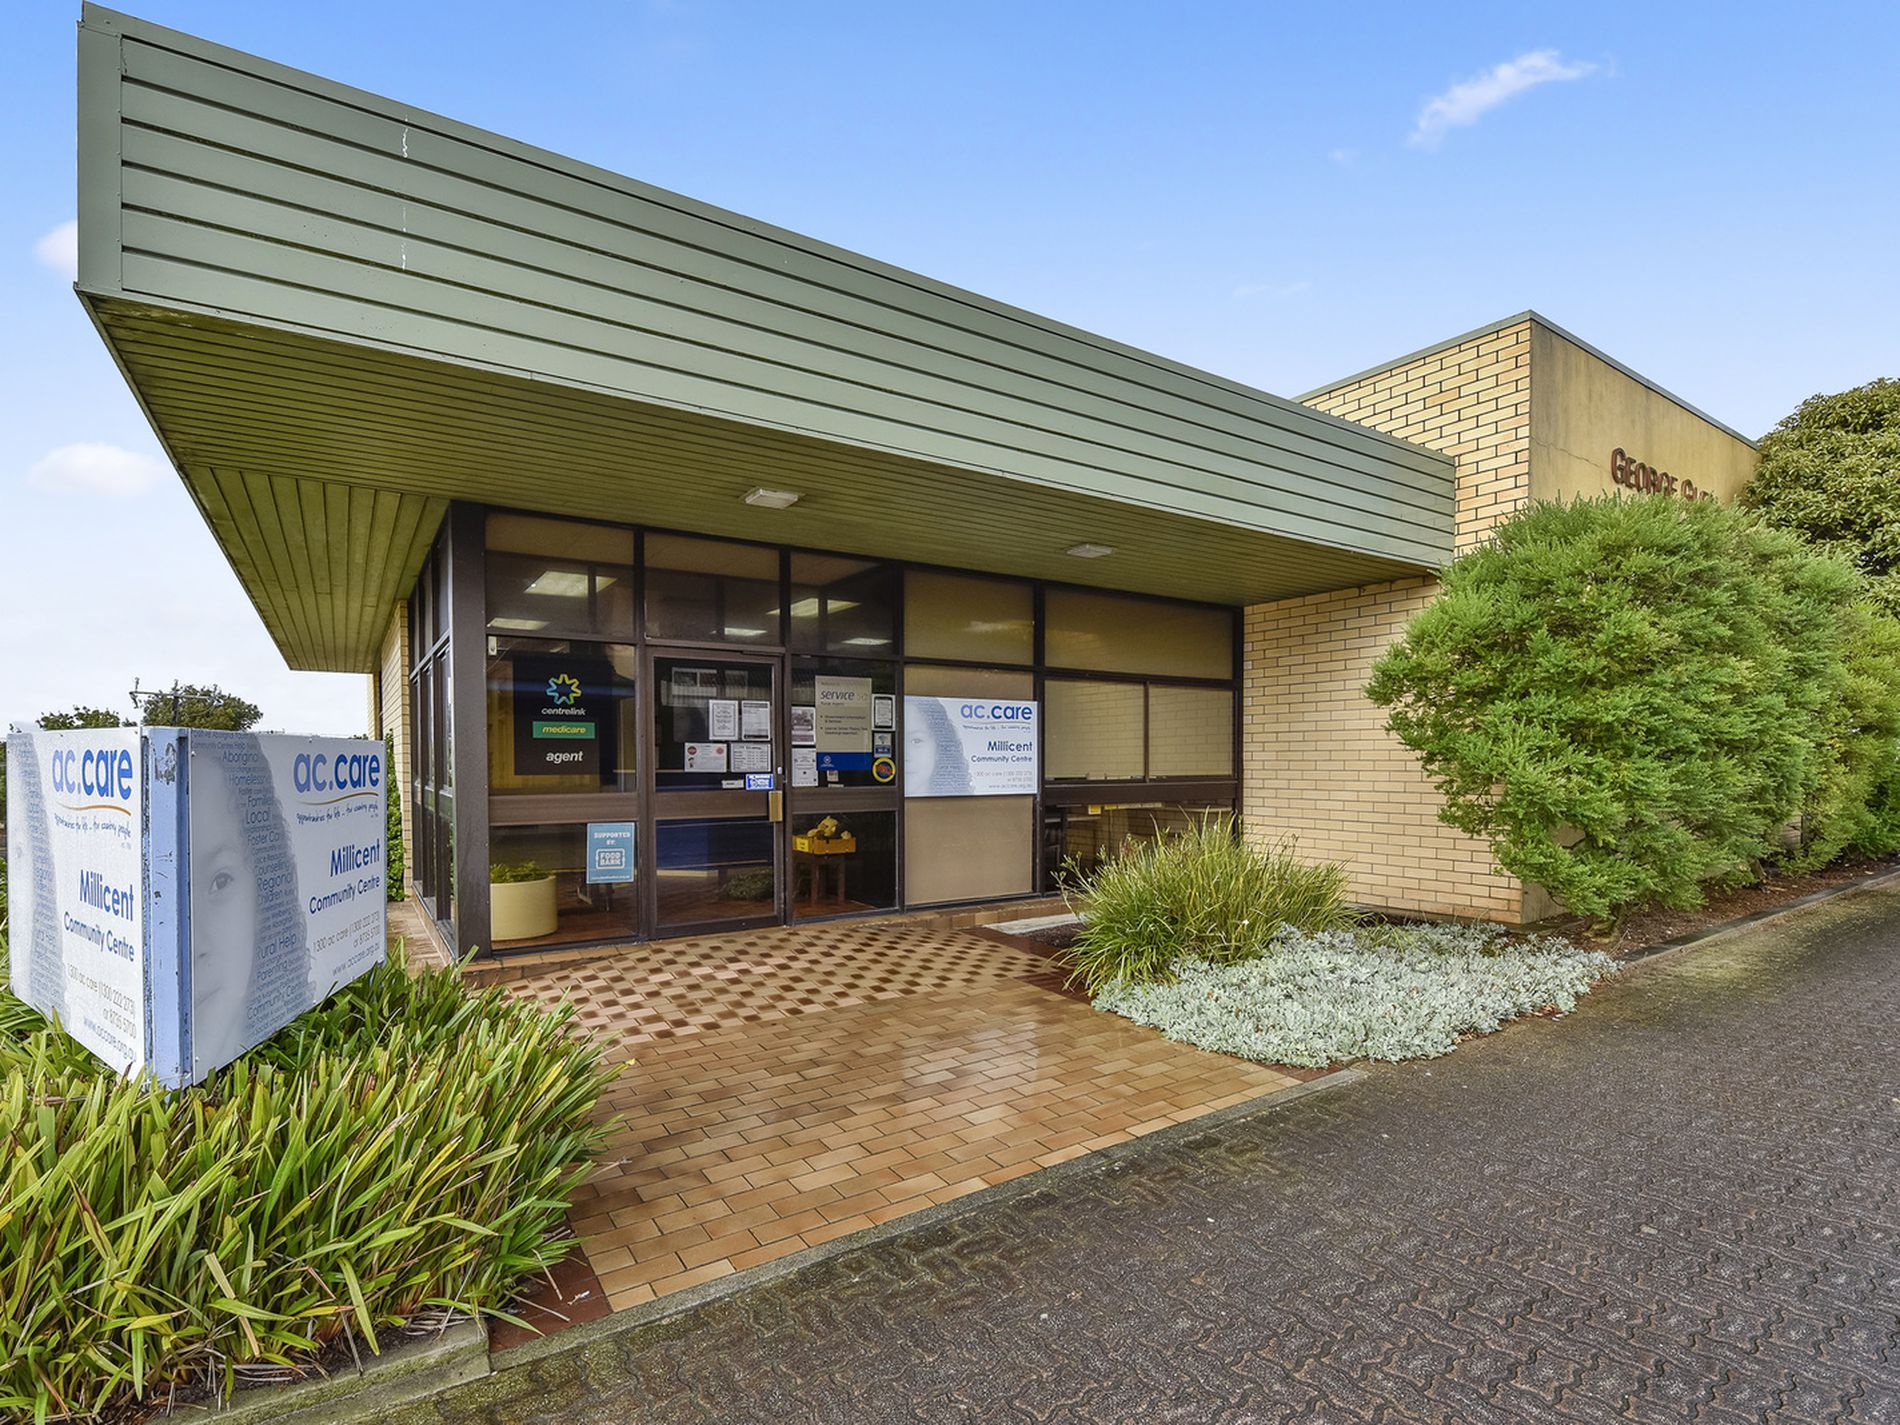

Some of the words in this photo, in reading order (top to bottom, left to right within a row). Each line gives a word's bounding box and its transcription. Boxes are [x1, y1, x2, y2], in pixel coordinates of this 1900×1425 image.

[541, 707, 586, 716] centrelink
[960, 704, 1033, 720] ac.care
[542, 725, 587, 734] medicare
[546, 750, 584, 764] agent
[971, 754, 1009, 763] Community
[1010, 754, 1033, 763] Centre
[987, 741, 1033, 752] Millicent
[52, 749, 133, 801] ac.care
[294, 752, 380, 794] ac.care
[330, 838, 380, 877] Millicent
[79, 869, 135, 922] Millicent
[309, 882, 357, 915] Community
[357, 874, 380, 894] Centre
[63, 911, 106, 953] Community
[106, 928, 135, 962] Centre
